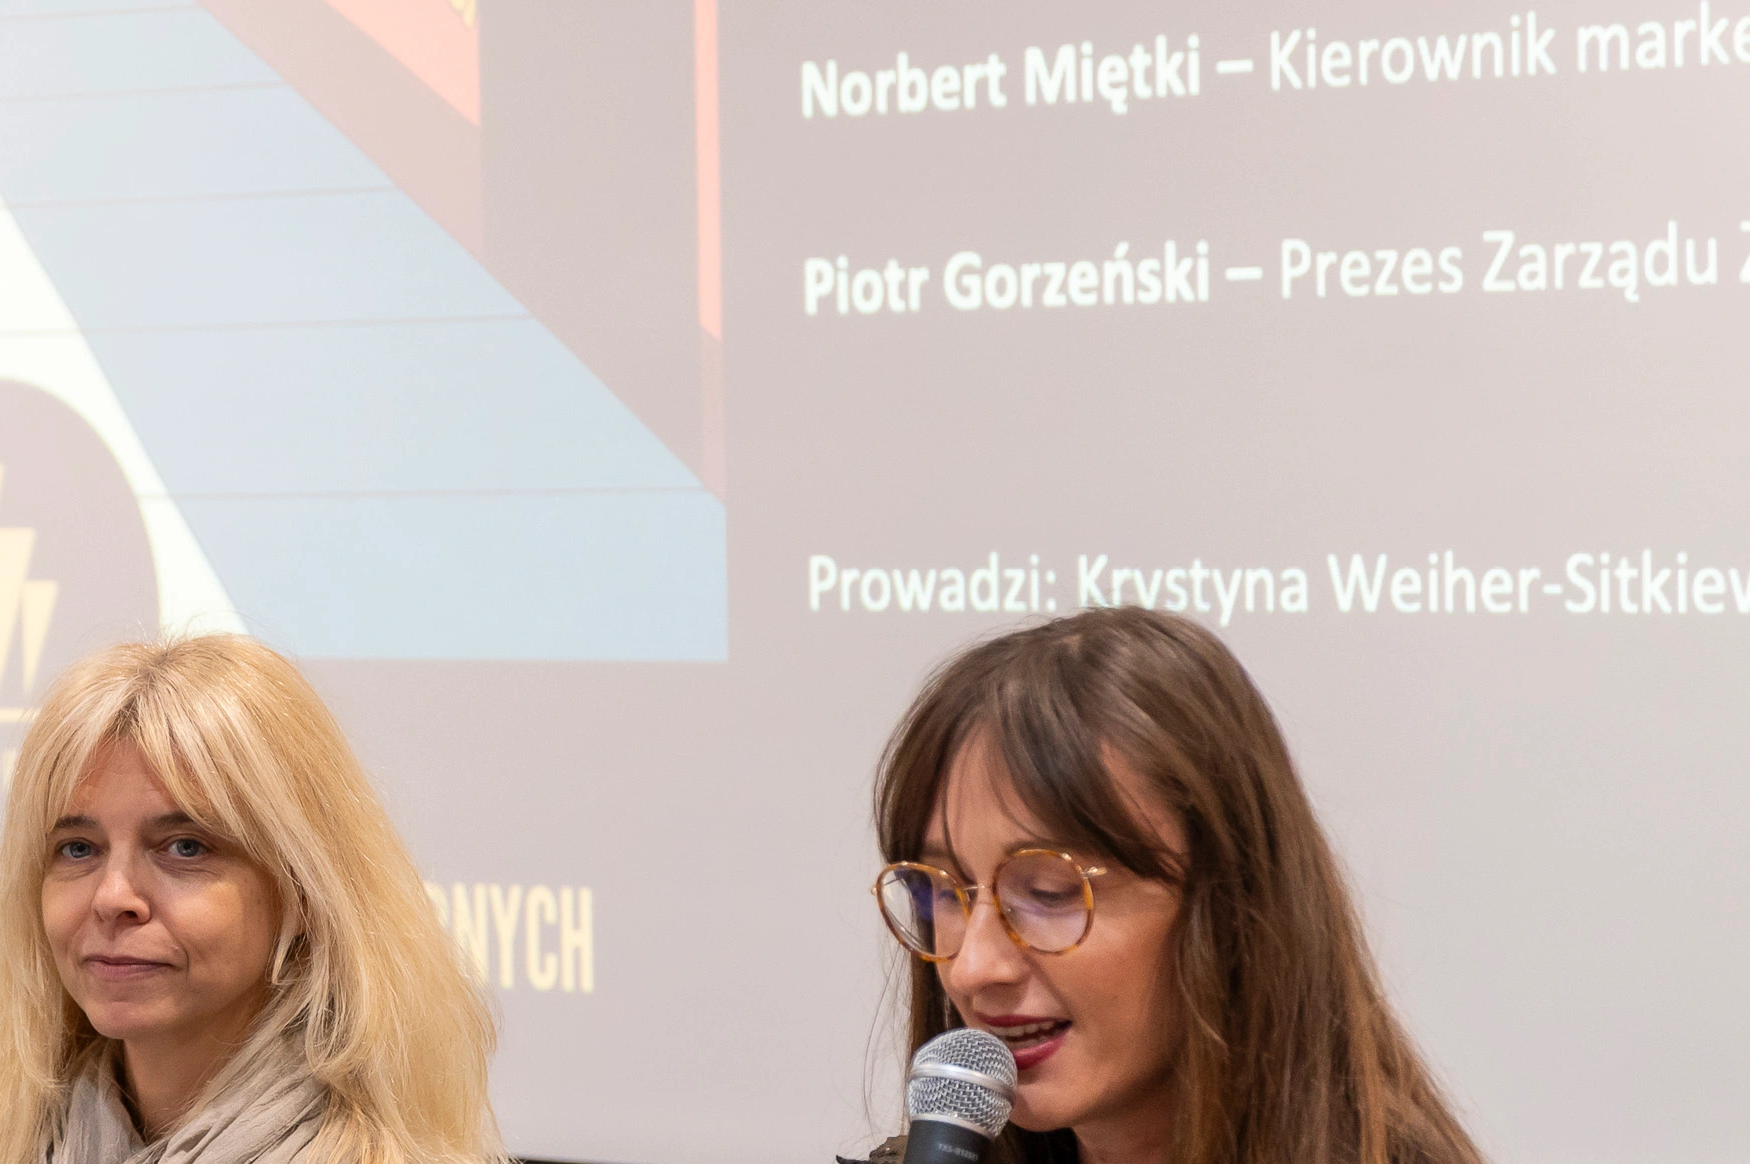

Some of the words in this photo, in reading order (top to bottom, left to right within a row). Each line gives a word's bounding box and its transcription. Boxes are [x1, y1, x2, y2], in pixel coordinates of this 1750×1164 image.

[801, 52, 1007, 118] Norbert
[1025, 34, 1200, 115] Miętki
[1271, 10, 1556, 91] Kierownik
[805, 256, 929, 315] Piotr
[944, 240, 1209, 311] Gorzeński
[1282, 239, 1463, 299] Prezes
[1482, 220, 1717, 303] Zarządu
[809, 552, 1056, 612] Prowadzi:
[1077, 552, 1308, 626] Krystyna
